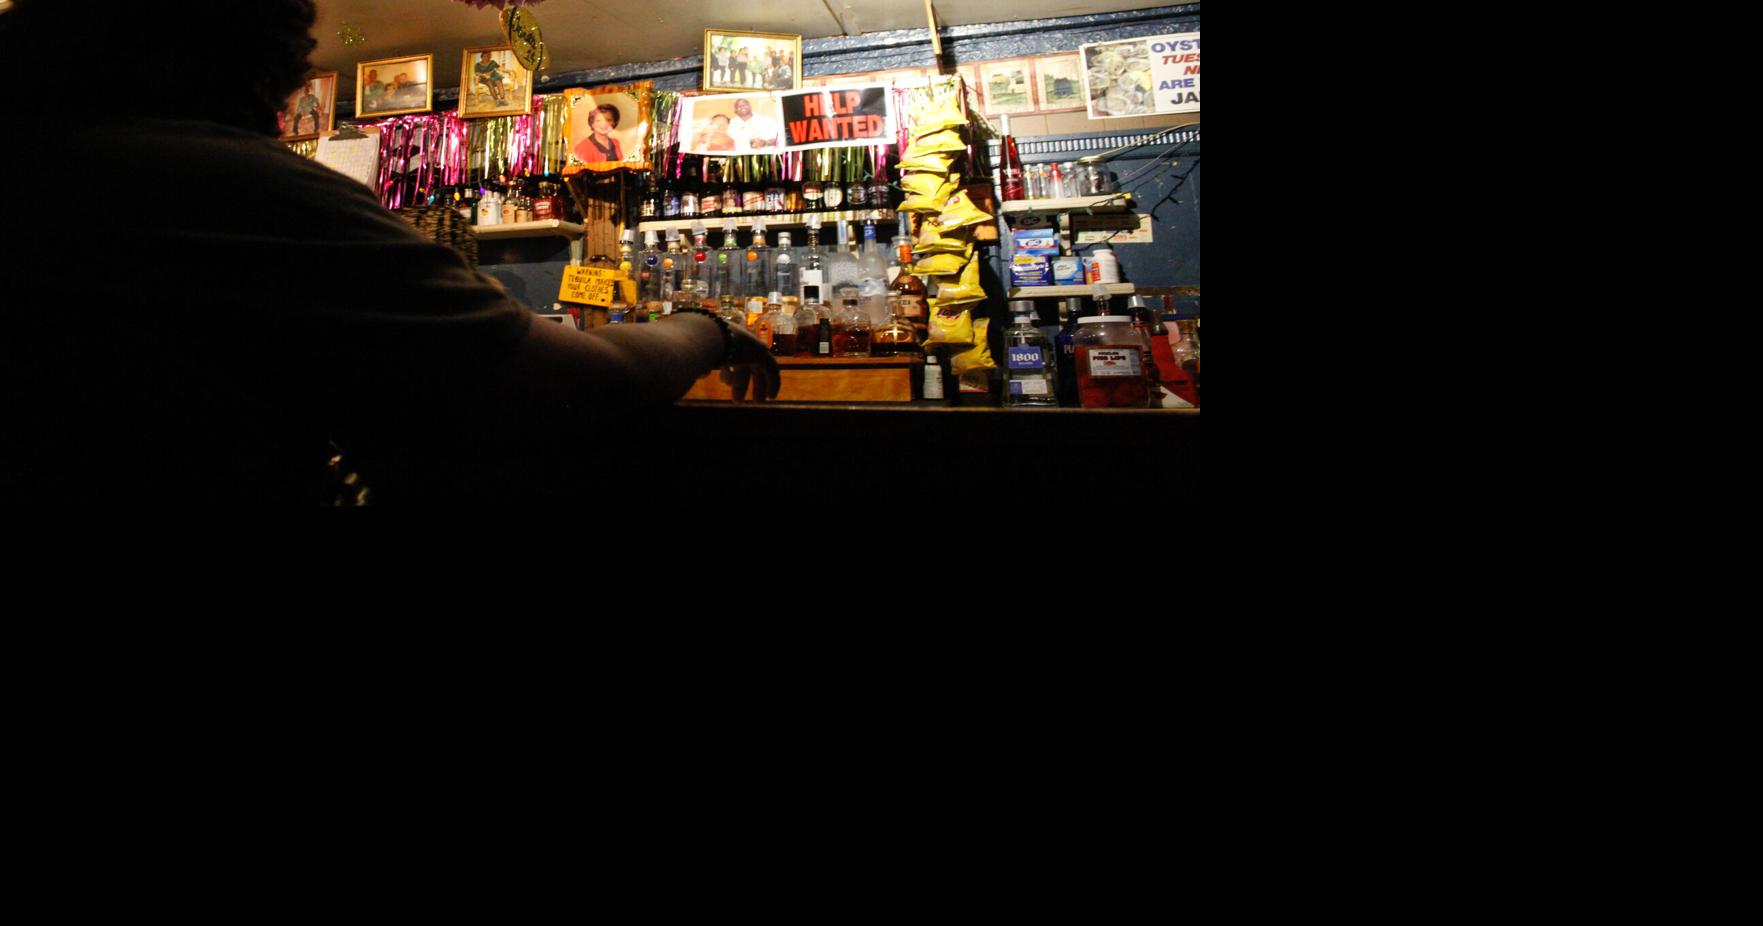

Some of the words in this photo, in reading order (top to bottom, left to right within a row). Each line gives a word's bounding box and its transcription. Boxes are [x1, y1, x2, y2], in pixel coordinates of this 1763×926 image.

[1159, 78, 1195, 90] ARE
[789, 114, 884, 143] WANTED
[1012, 352, 1039, 362] 1800
